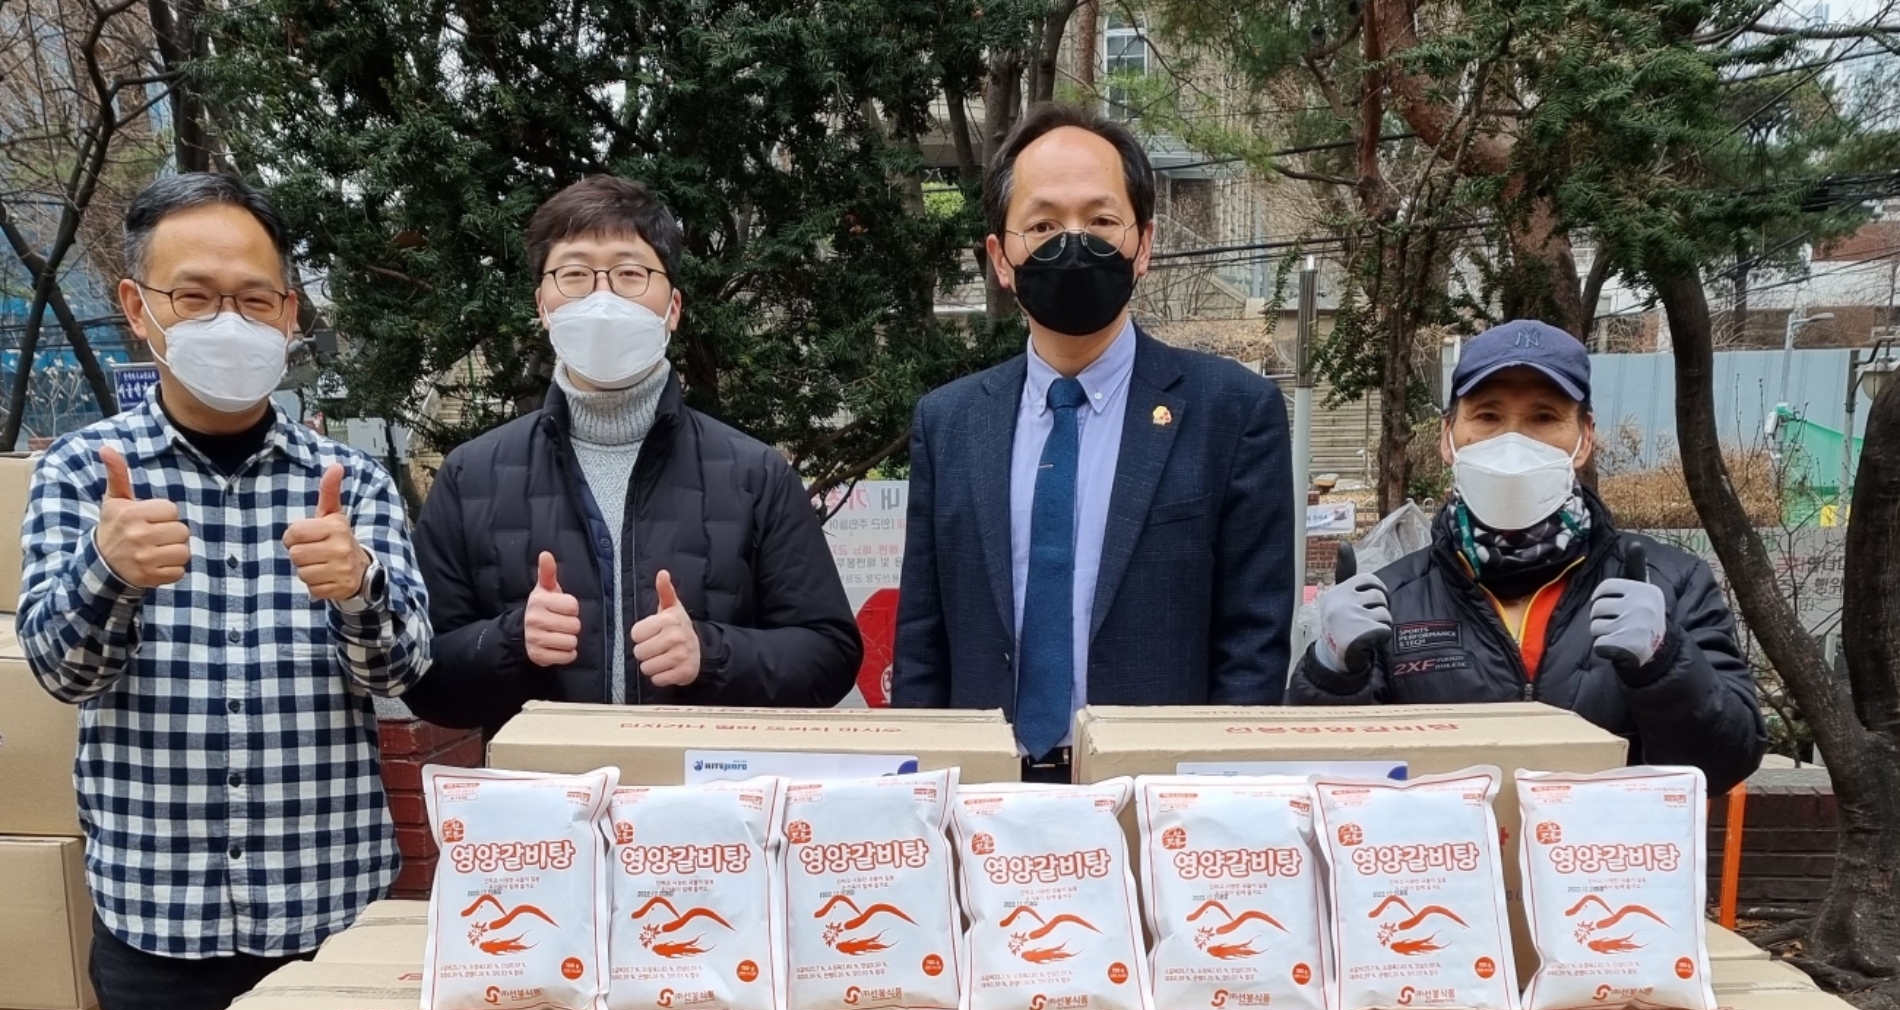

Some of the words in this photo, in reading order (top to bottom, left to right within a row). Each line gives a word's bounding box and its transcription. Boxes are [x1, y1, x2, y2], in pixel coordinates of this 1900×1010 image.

[1394, 659, 1435, 675] 2XF
[451, 840, 576, 874] 영양갈비탕
[621, 844, 750, 874] 영양갈비탕
[800, 838, 928, 875] 영양갈비탕
[984, 848, 1110, 884] 영양갈비탕
[1174, 848, 1301, 879] 영양갈비탕
[1352, 842, 1479, 875] 영양갈비탕
[1550, 843, 1680, 874] 영양갈비탕
